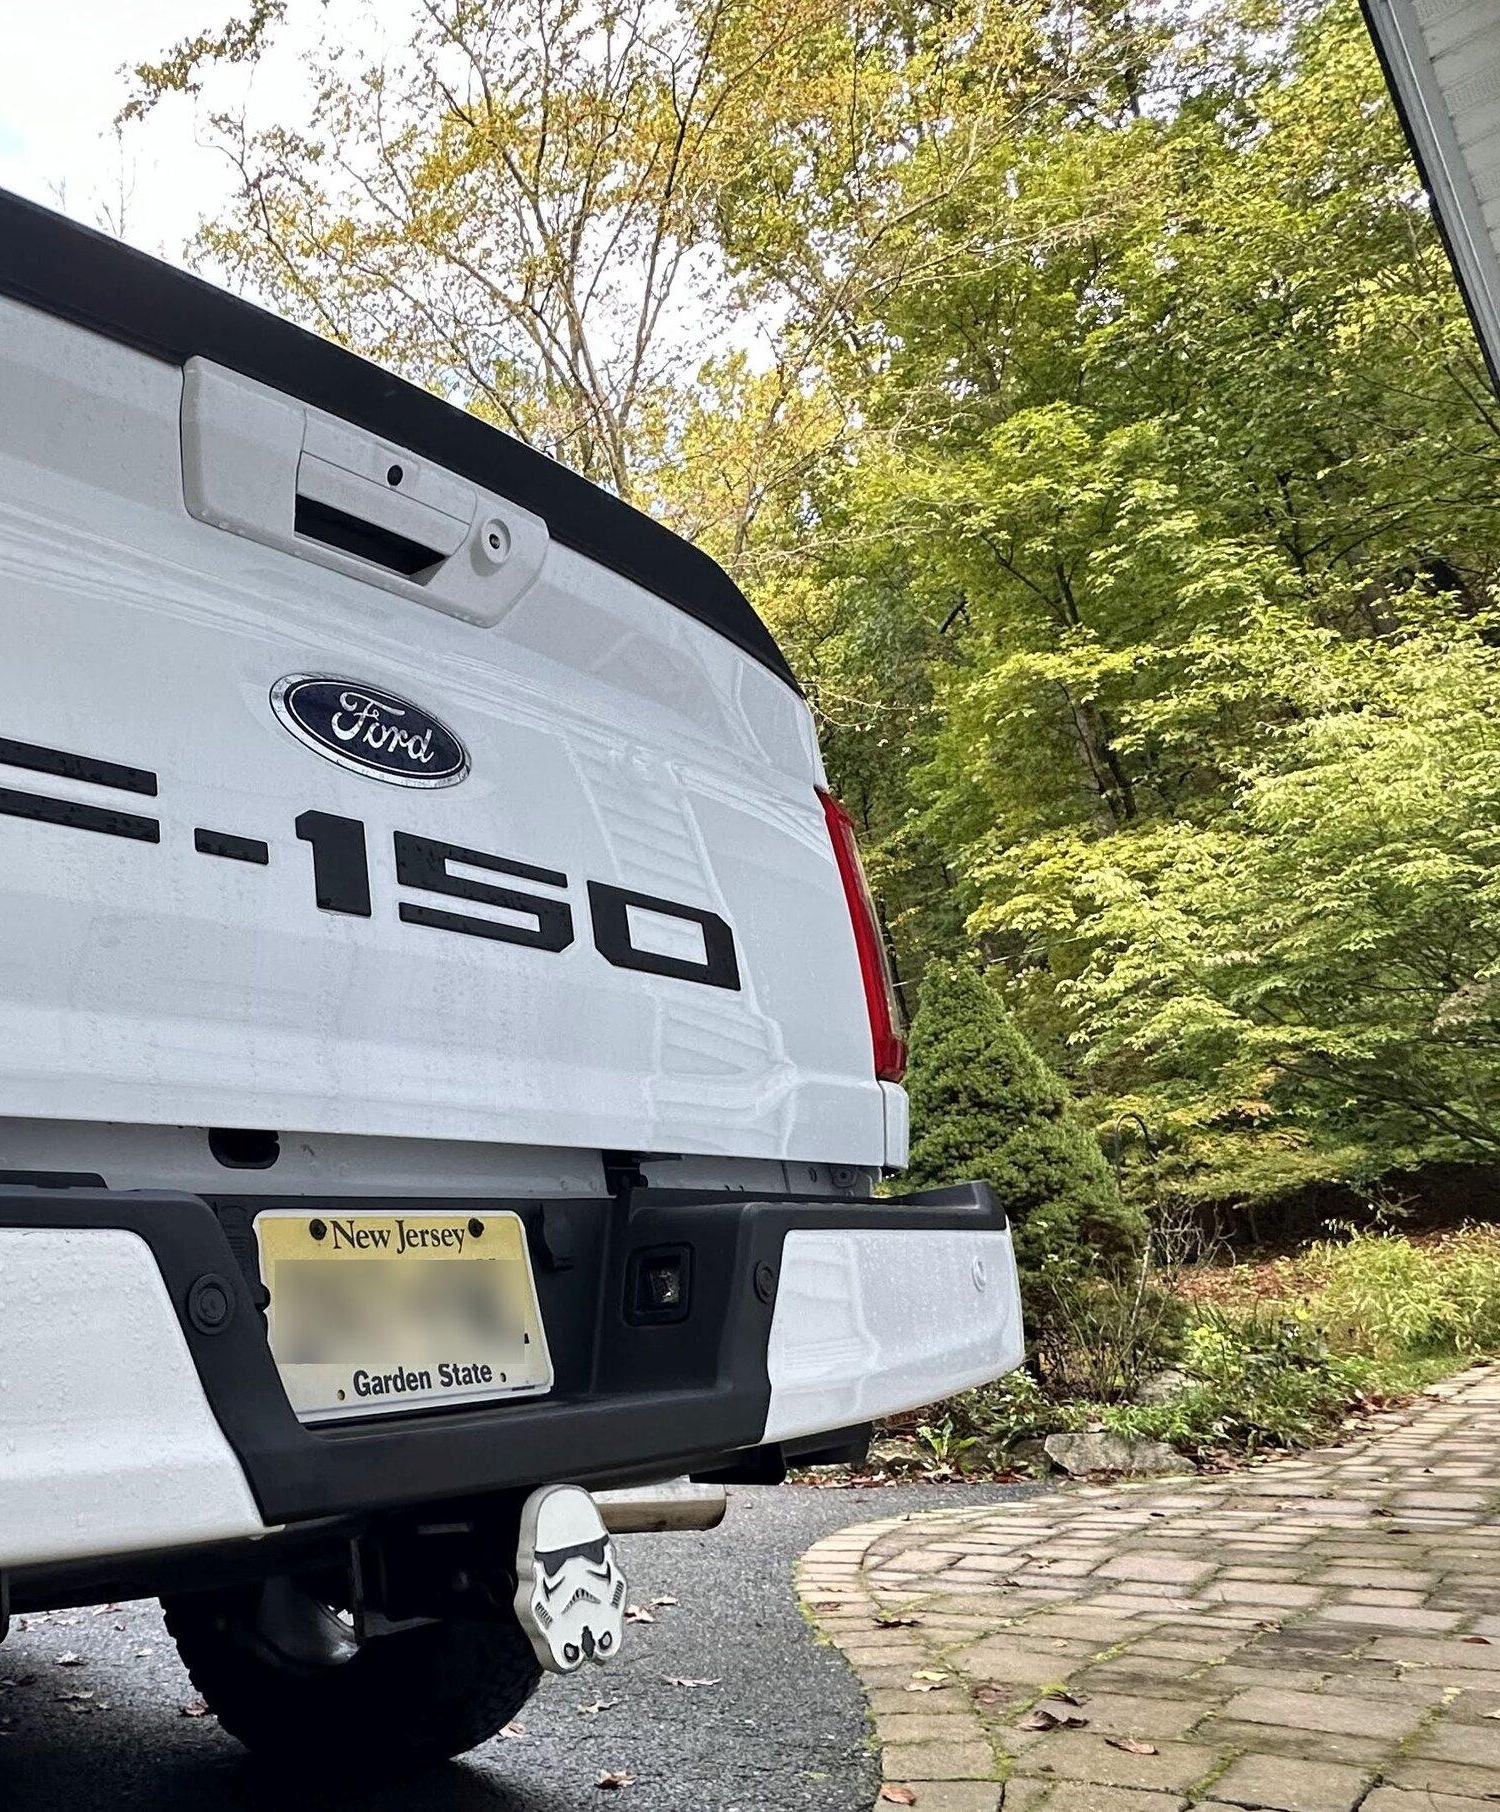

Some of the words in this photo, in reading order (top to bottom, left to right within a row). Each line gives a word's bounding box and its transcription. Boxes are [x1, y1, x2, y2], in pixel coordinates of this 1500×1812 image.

[329, 691, 434, 766] Ford
[329, 1219, 392, 1250] New
[394, 1219, 466, 1254] Jersey
[352, 1366, 433, 1397] Garden
[437, 1363, 493, 1388] State
